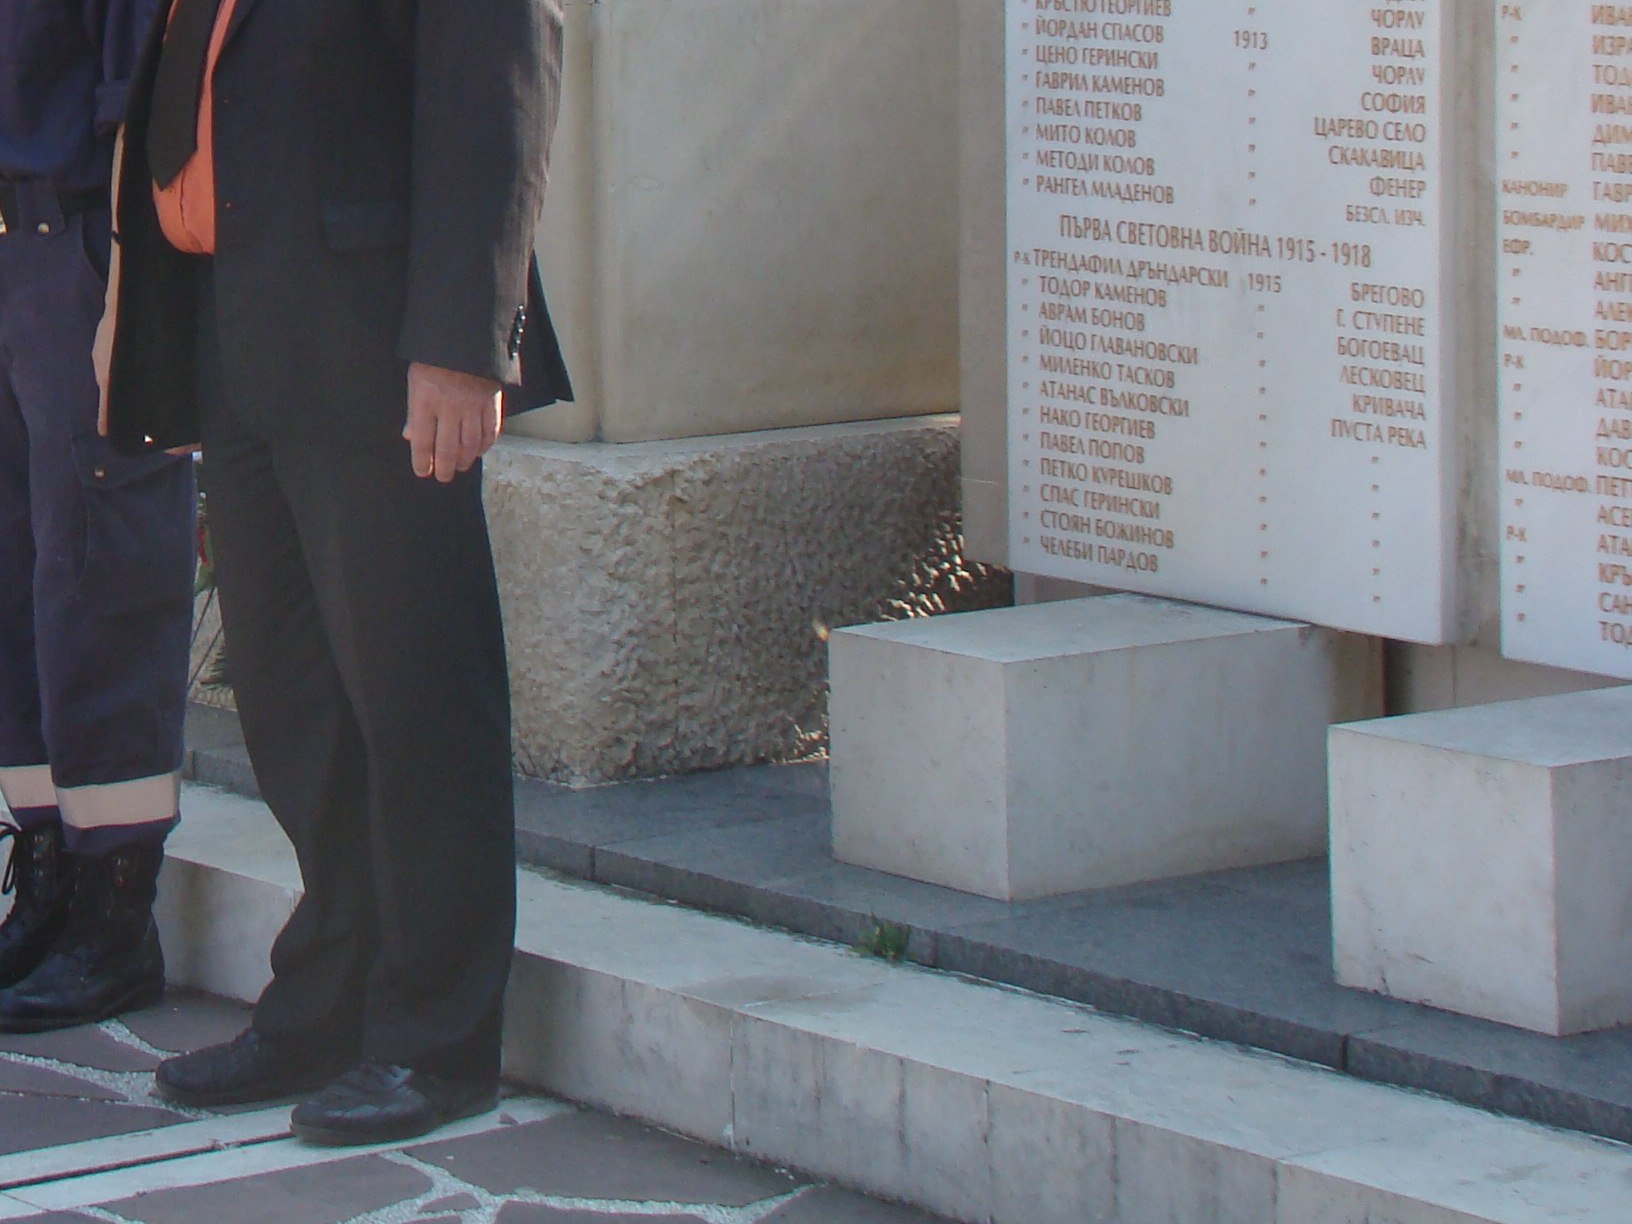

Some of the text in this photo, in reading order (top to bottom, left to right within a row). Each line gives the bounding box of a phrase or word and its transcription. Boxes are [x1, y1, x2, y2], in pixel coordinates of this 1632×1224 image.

[1035, 15, 1164, 43] ЙОРДАН СПАСОВ
[1371, 9, 1425, 29] ЧОРЛУ
[1234, 30, 1268, 50] 1913
[1371, 37, 1425, 58] ВРАЦА
[1036, 45, 1158, 69] ЦЕНО ГЕРИНСКИ
[1035, 71, 1165, 96] ГАВРИЛ КАМЕНОВ
[1371, 65, 1425, 85] ЧОРЛУ
[1036, 97, 1142, 121] ПАВЕЛ ПЕТКОВ
[1361, 92, 1426, 114] СОФИЯ
[1036, 124, 1136, 148] МИТО КОЛОВ
[1314, 117, 1426, 142] ЦАРЕВО СЕЛО
[1036, 150, 1155, 176] МЕТОДИ КОЛОВ
[1329, 146, 1425, 172] СКАКАВИЦА
[1036, 175, 1174, 204] РАНГЕЛ МЛАДЕНОВ
[1369, 176, 1426, 198] ФЕНЕР
[1059, 214, 1371, 268] ПЪРВА СВЕТОВНА ВОЙНА 1915 1918
[1033, 248, 1122, 275] ТРЕНДАФИЛ
[1127, 261, 1228, 288] ДРЪНДАРСКИ
[1039, 275, 1167, 307] ТОДОР КАМЕНОВ
[1248, 272, 1282, 293] 1915
[1351, 282, 1425, 308] БРЕГОВО
[1039, 302, 1145, 331] АВРАМ БОНОВ
[1039, 325, 1197, 364] ЙОЦО ГЛАВАНОВСКИ
[1039, 354, 1174, 389] МИЛЕНКО ТАСКОВ
[1340, 365, 1426, 394] ЛЕСКОВЕЦ
[1040, 380, 1096, 404] АТАНАС
[1595, 388, 1632, 409] АТА
[1040, 405, 1155, 439] НАКО ГЕОРГИЕВ
[1331, 418, 1426, 449] ПУСТА РЕКА
[1040, 432, 1144, 464] ПАВЕЛ ПОПОВ
[1041, 457, 1088, 481] ПЕТКО
[1040, 483, 1160, 519] СПАС ГЕРИНСКИ
[1040, 509, 1174, 549] СТОЯН БОЖИНОВ
